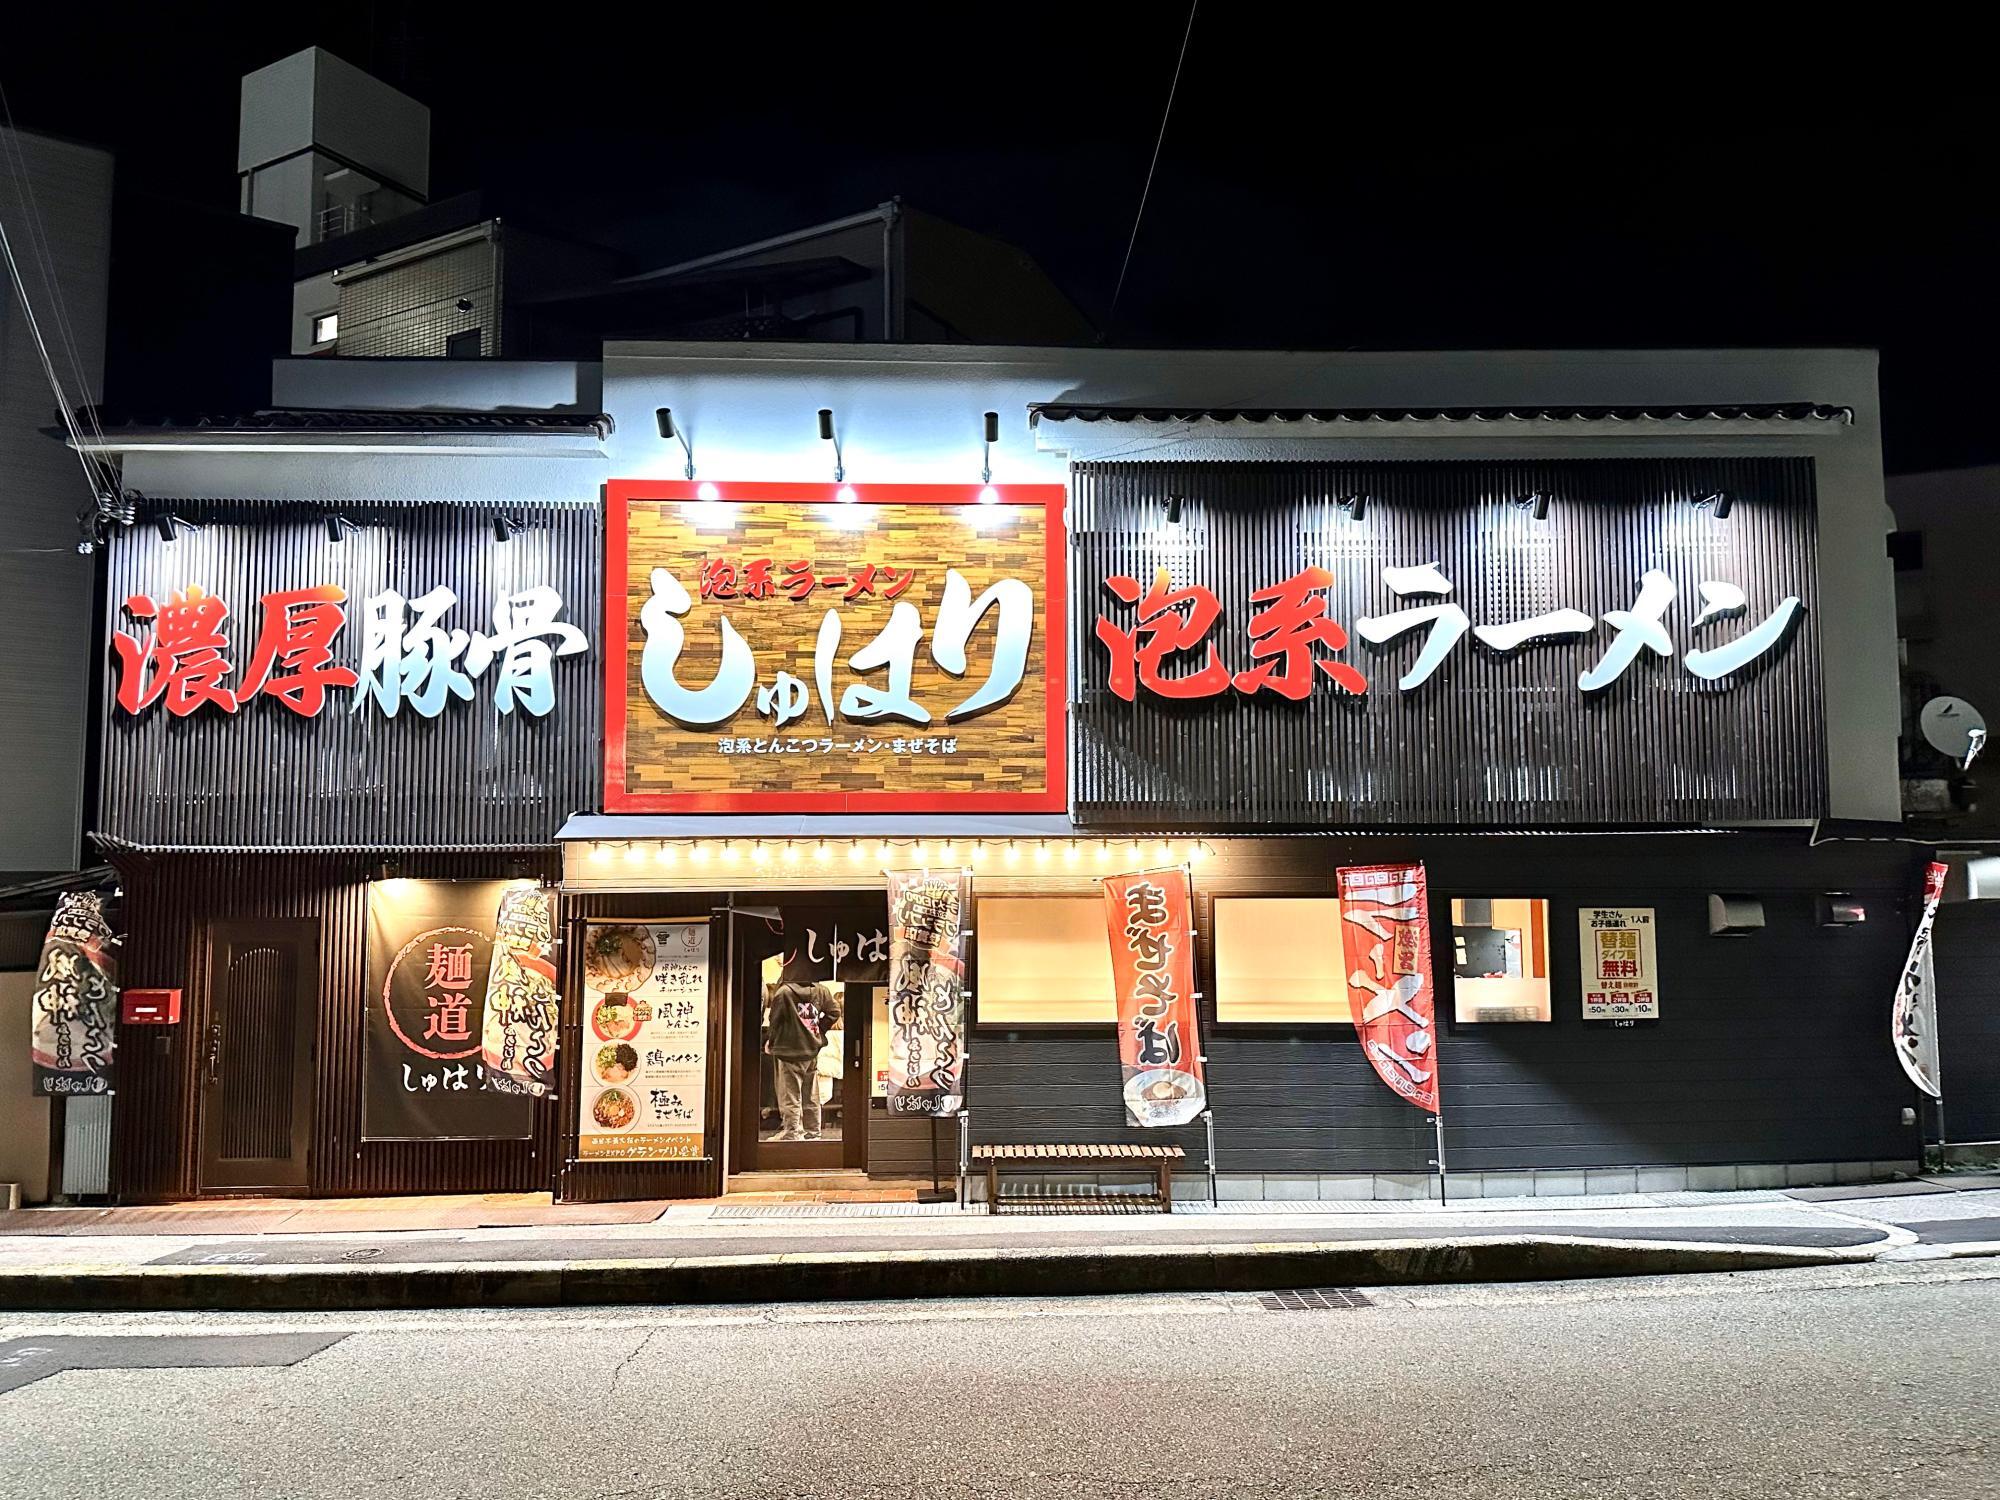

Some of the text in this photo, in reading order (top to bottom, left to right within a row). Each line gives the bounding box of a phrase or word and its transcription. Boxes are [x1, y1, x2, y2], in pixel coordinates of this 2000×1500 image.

[700, 558, 914, 600] 泡系ラーメン
[1095, 560, 1802, 703] 泡系ラーメン
[113, 583, 589, 718] 濃厚豚骨
[640, 567, 1034, 728] しゅはり
[717, 736, 957, 755] 泡系とんこつラーメン・まぜそば
[1593, 911, 1622, 919] 学生さん
[1602, 960, 1638, 977] 無料
[655, 973, 703, 985] 咲き乱れ
[658, 1001, 694, 1020] 風神
[667, 1020, 700, 1028] とんこつ
[650, 1088, 683, 1107] 極み
[655, 1108, 694, 1119] まぜそば
